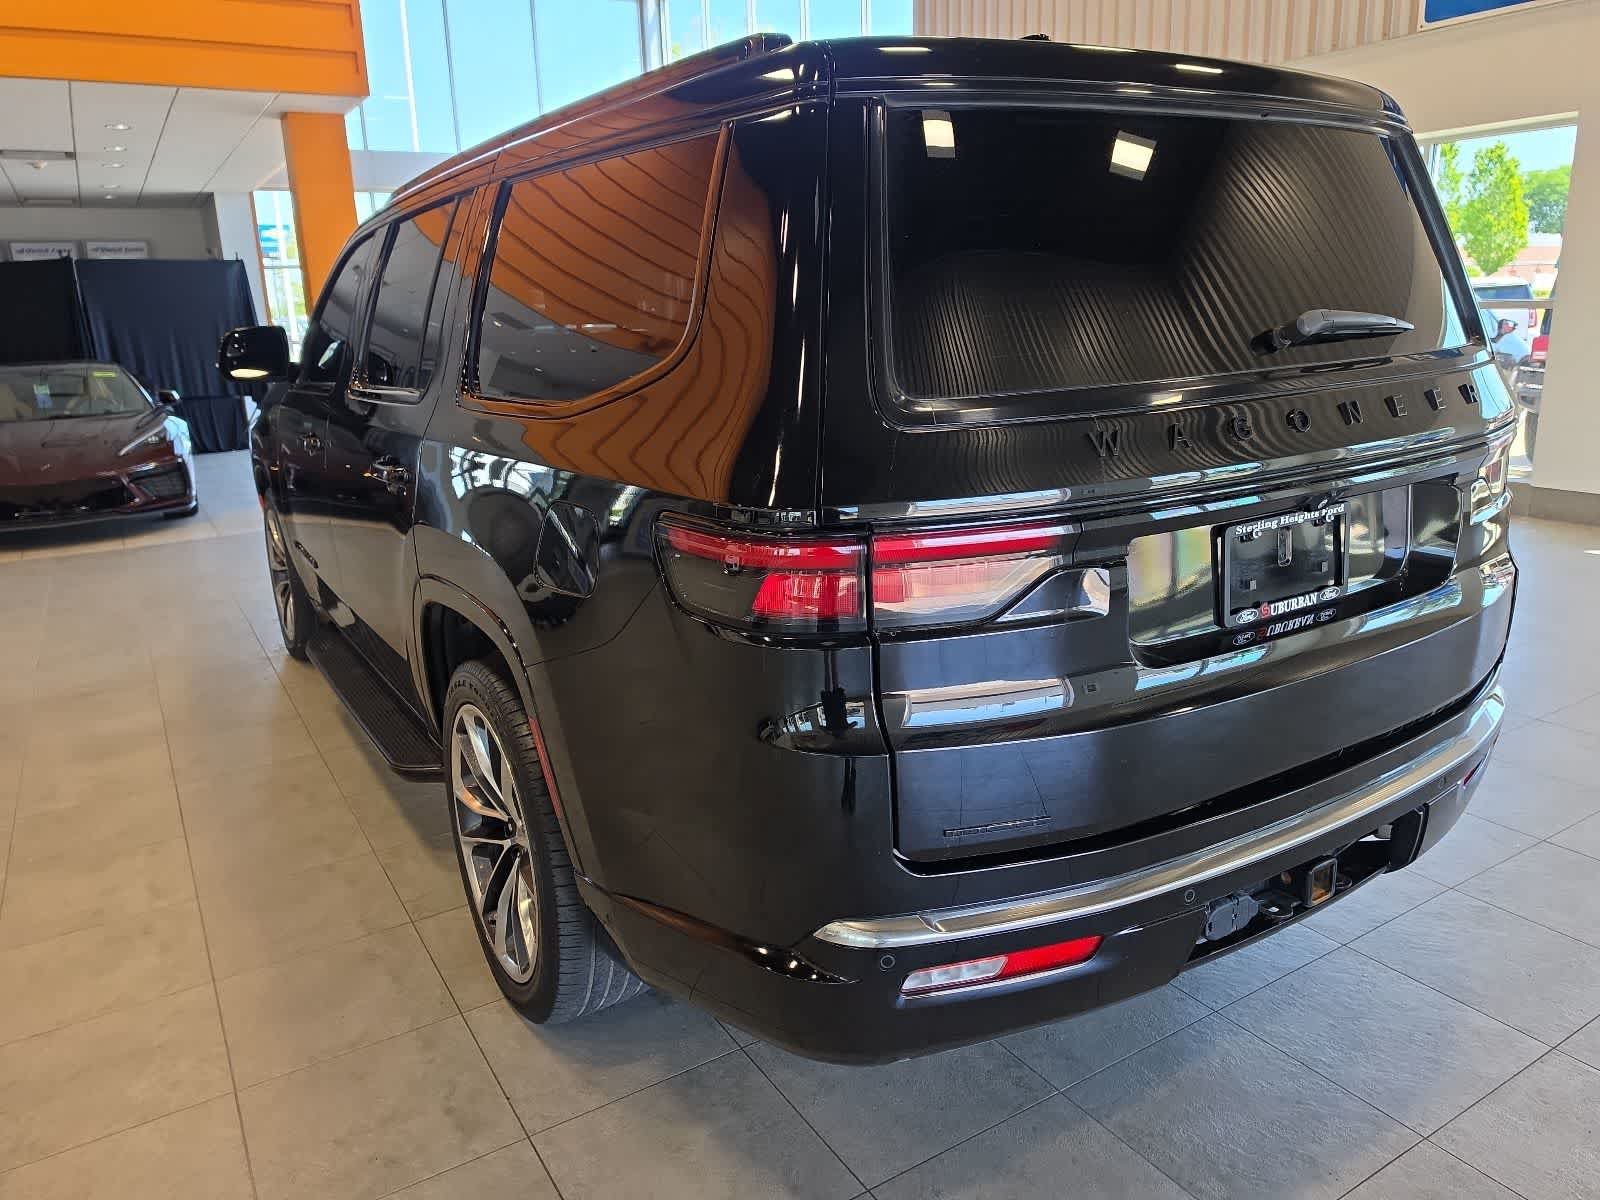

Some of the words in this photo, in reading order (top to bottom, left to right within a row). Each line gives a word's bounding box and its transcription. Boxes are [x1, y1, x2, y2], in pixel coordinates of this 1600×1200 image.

[1087, 382, 1480, 457] WAGONEER
[1235, 520, 1278, 535] Sterling
[1280, 509, 1320, 525] Heights
[1320, 503, 1345, 517] Ford
[1260, 591, 1318, 618] SUBURBAN
